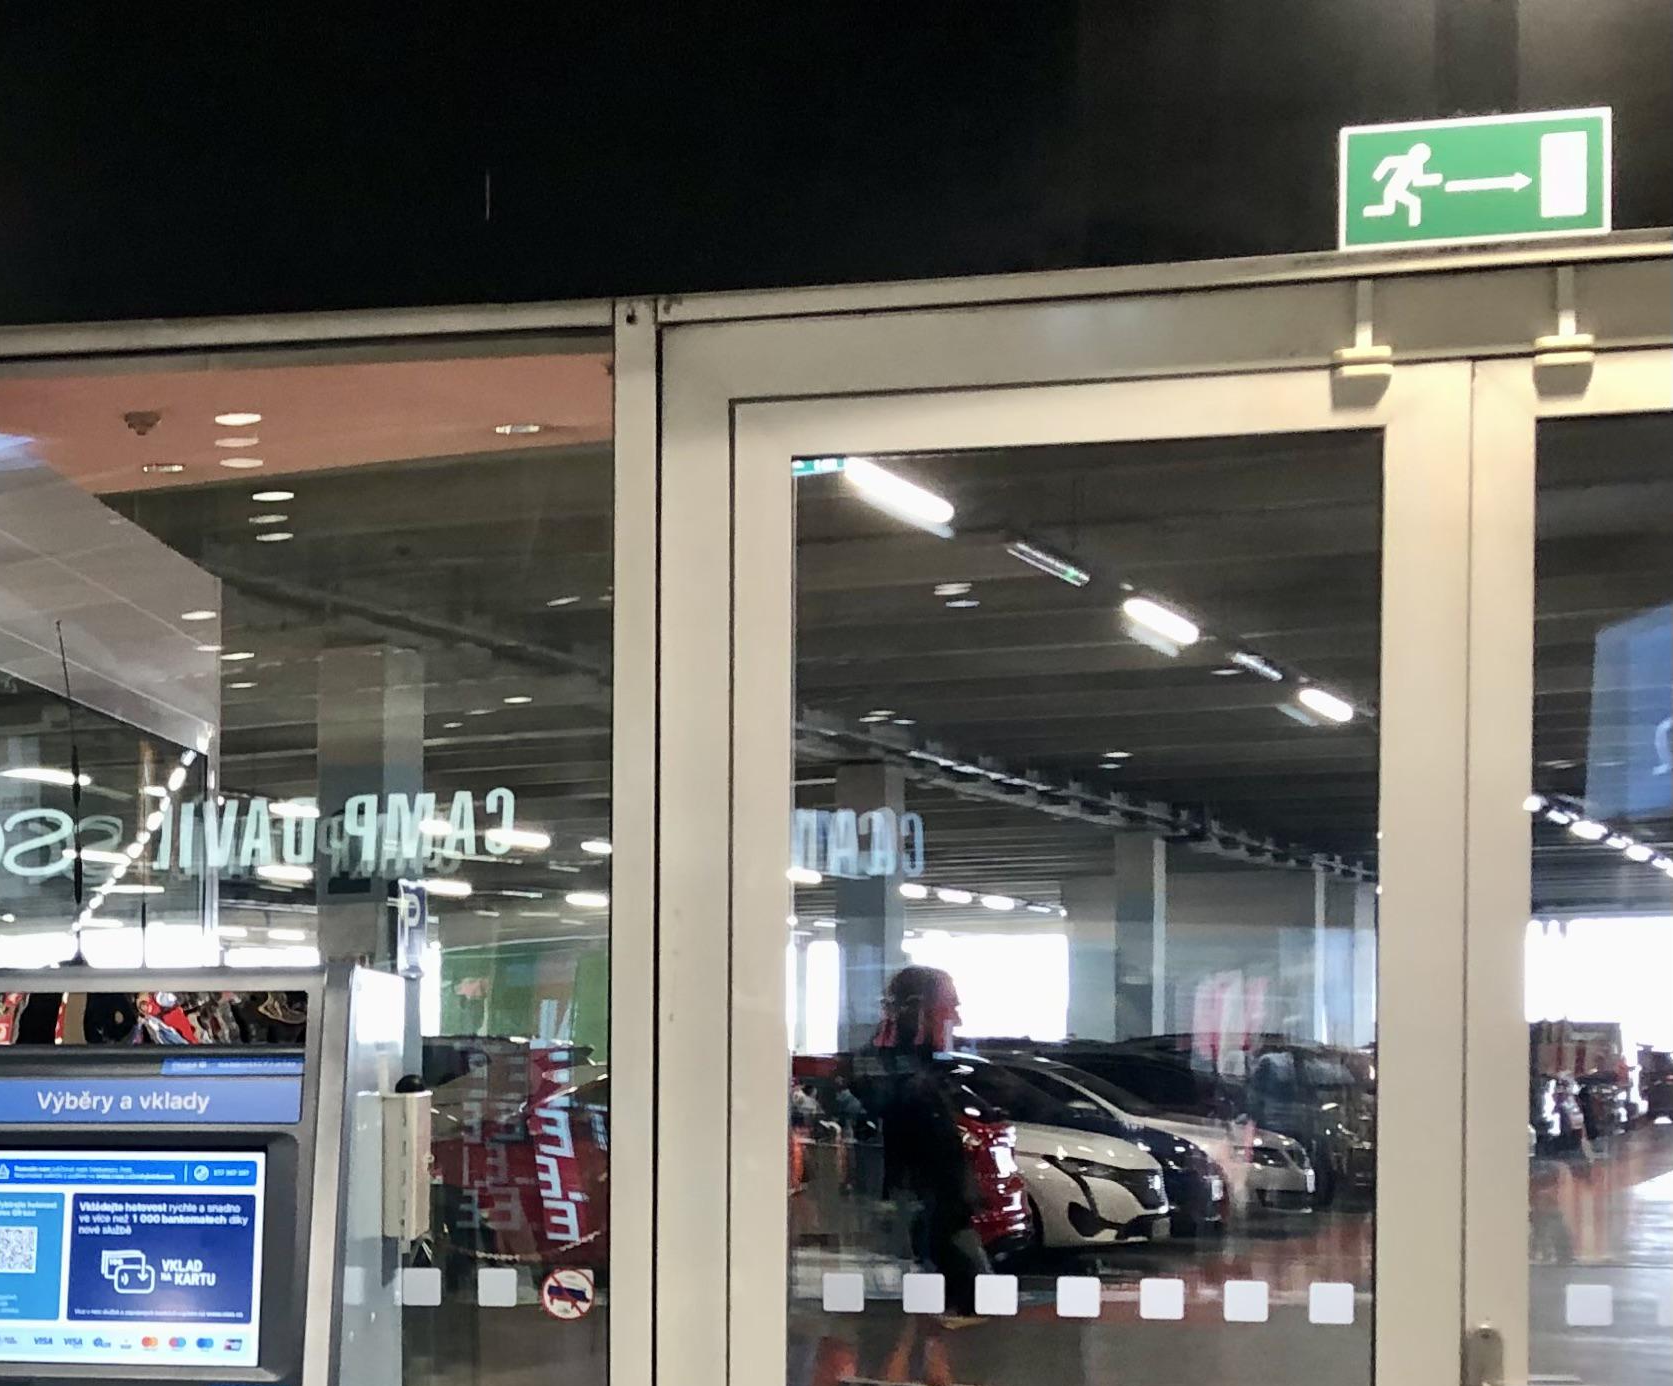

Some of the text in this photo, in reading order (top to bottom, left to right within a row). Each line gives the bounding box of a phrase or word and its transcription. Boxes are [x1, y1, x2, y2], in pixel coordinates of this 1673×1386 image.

[37, 1089, 210, 1115] Výběry a vklady
[125, 1202, 167, 1213] hotovost
[169, 1202, 197, 1214] rychle
[207, 1204, 241, 1213] snadno
[79, 1215, 91, 1224] ve
[92, 1214, 110, 1224] více
[112, 1214, 129, 1224] než
[162, 1215, 227, 1225] bankomatech
[78, 1225, 132, 1235] nové službě
[162, 1258, 203, 1272] VKLAD
[174, 1274, 217, 1287] KARTU
[34, 1336, 53, 1346] VISA
[64, 1337, 83, 1347] VISA
